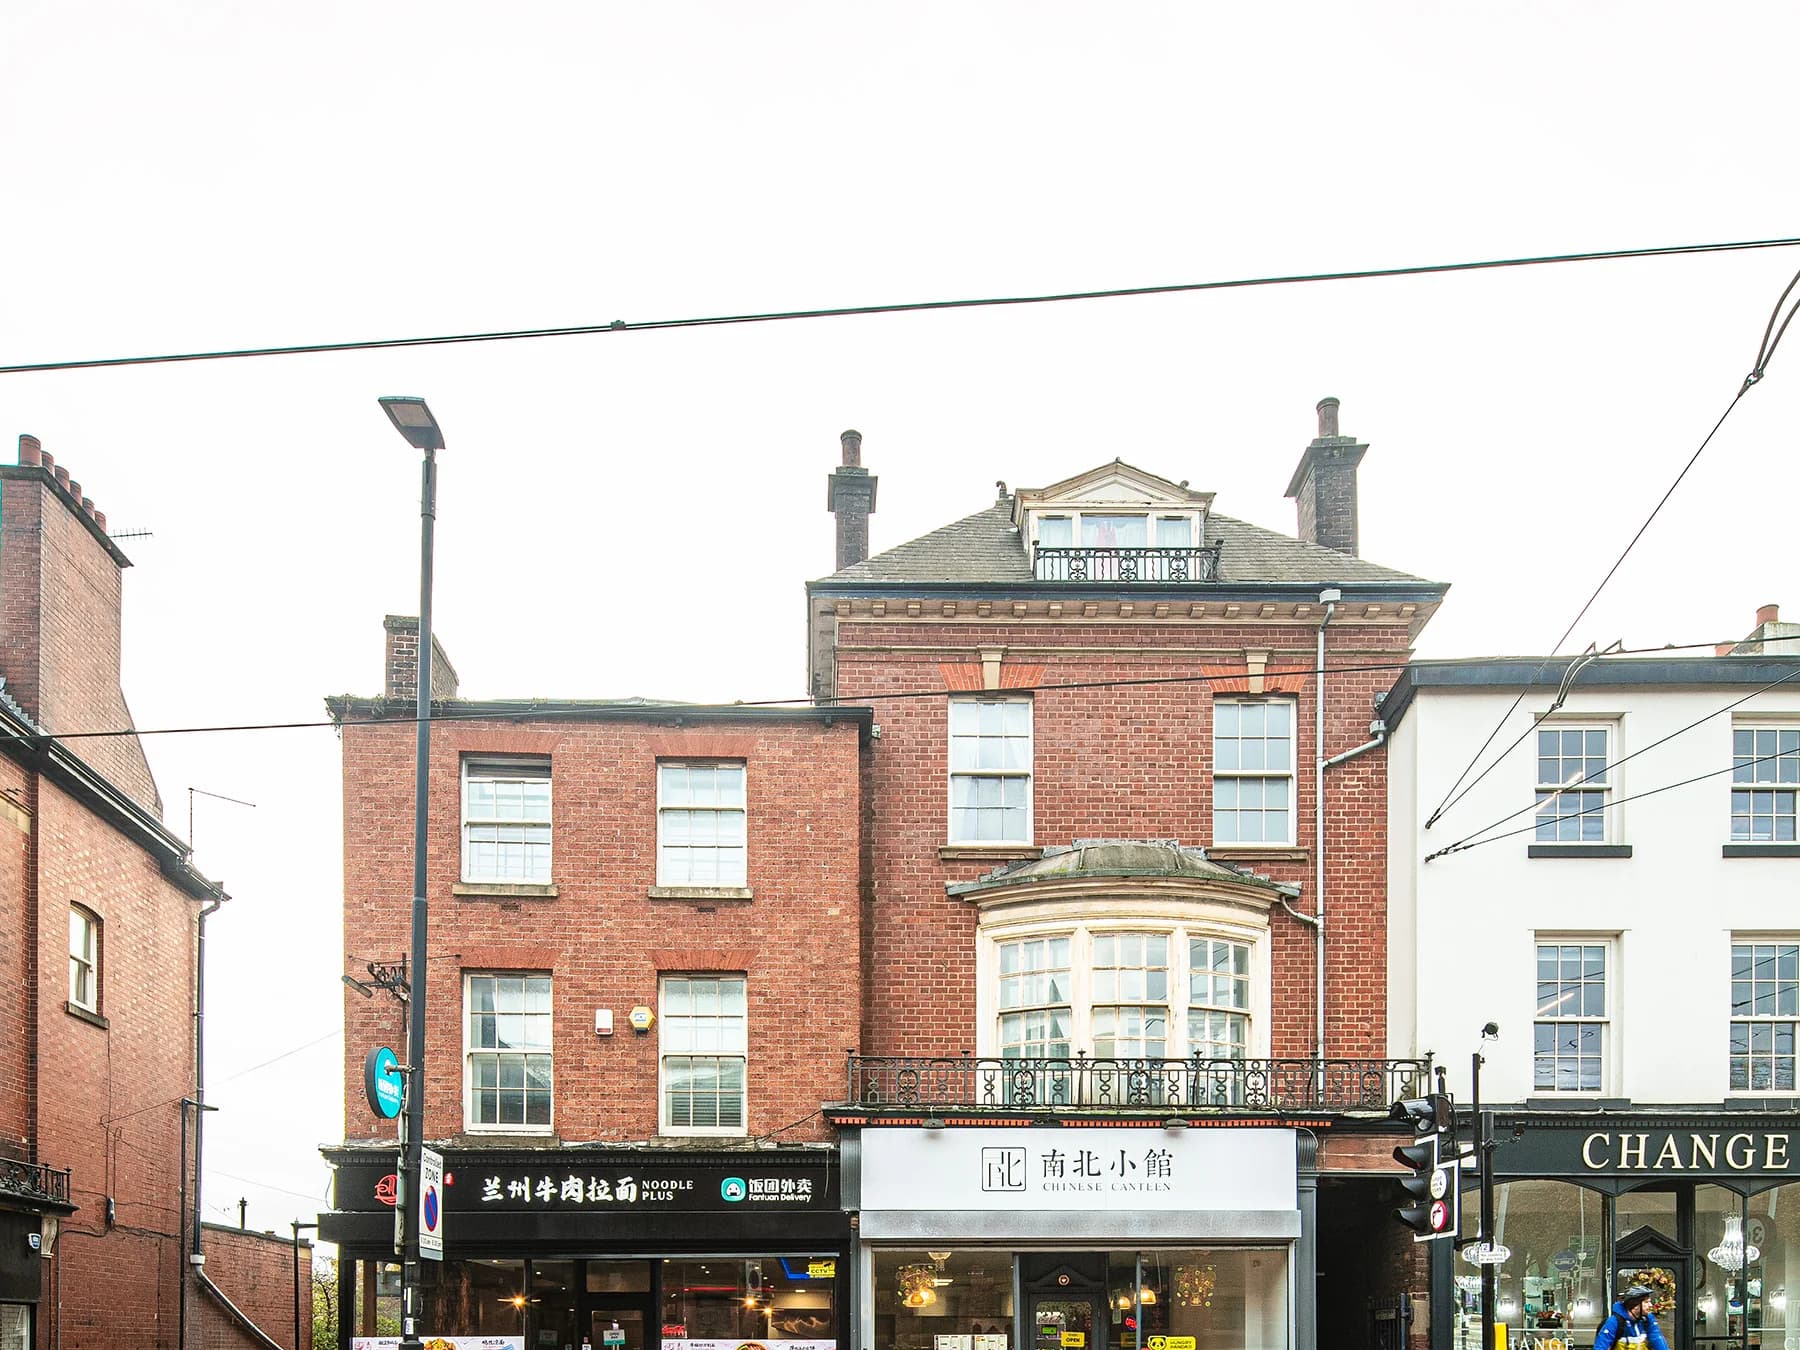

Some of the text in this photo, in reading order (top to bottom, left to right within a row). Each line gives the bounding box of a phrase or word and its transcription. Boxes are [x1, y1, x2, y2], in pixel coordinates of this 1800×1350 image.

[1582, 1132, 1790, 1170] CHANGE
[1041, 1148, 1174, 1178] 南北小館
[425, 1167, 439, 1184] ZONE
[481, 1174, 638, 1203] 兰州牛肉拉面
[642, 1180, 693, 1190] NOODLE
[748, 1178, 812, 1194] 饭团外卖
[1043, 1182, 1171, 1192] CHINESE CANTEEN
[642, 1191, 674, 1201] PLUS
[748, 1193, 812, 1203] Fantuan Delivery
